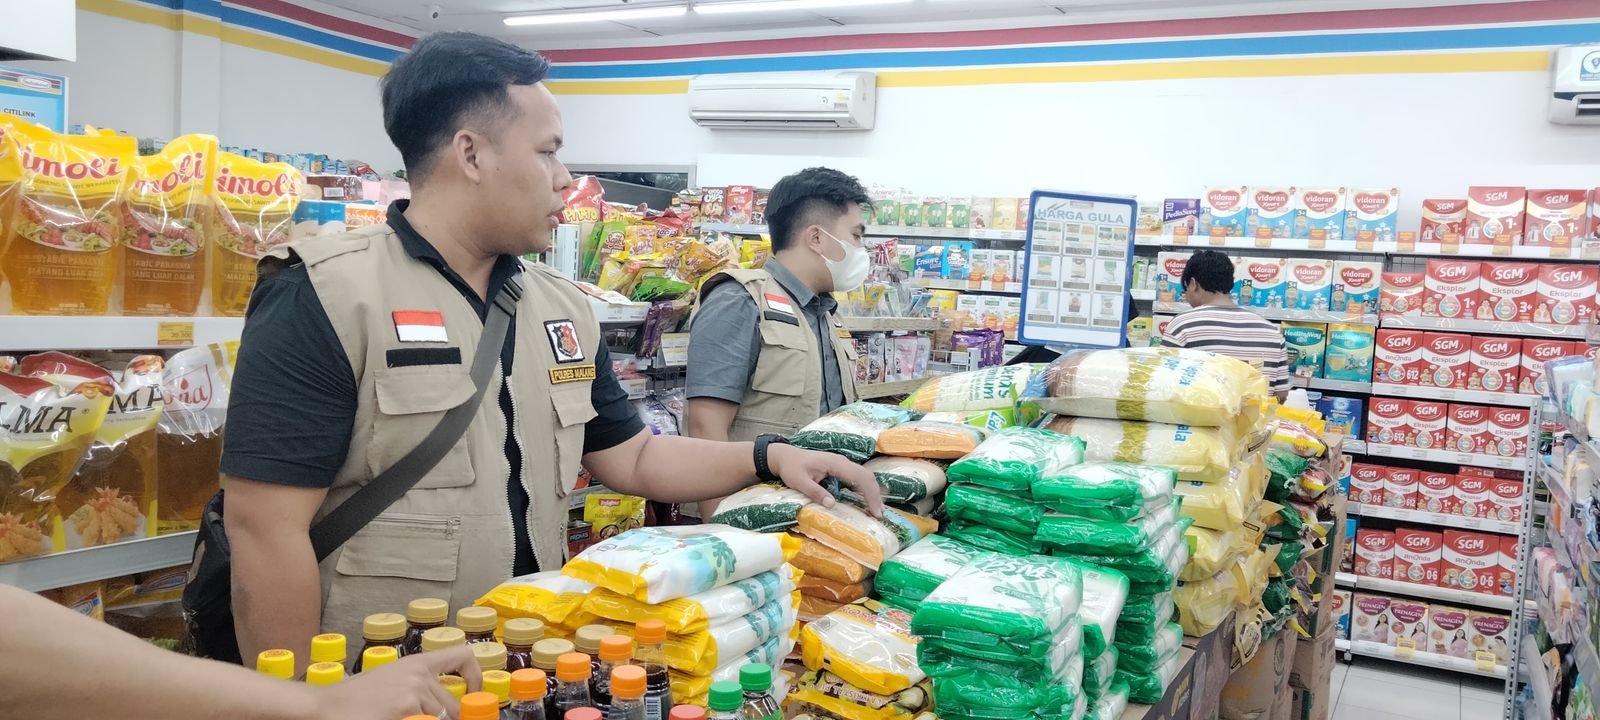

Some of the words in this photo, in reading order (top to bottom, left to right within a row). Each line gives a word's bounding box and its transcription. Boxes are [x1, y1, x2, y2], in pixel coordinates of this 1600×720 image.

[3, 108, 36, 118] CITILINK
[1485, 192, 1508, 201] SGM
[1546, 195, 1569, 205] SGM
[1436, 202, 1455, 210] SGM
[1037, 208, 1084, 221] HARGA
[1088, 212, 1124, 224] GULA
[1165, 209, 1197, 220] PediaSure
[916, 258, 940, 266] Ensure
[1295, 268, 1321, 276] vidoran
[1342, 271, 1370, 279] vidoran
[1439, 266, 1467, 277] SGM
[1495, 269, 1524, 280] SGM
[1553, 271, 1583, 282] SGM
[1394, 276, 1411, 284] SGM
[1436, 284, 1467, 292] Eksplor
[1492, 287, 1525, 295] Eksplor
[1549, 290, 1583, 298] Eksplor
[1387, 336, 1411, 347] SGM
[1435, 340, 1459, 350] SGM
[1483, 343, 1507, 353] SGM
[1535, 346, 1561, 357] SGM
[1360, 358, 1368, 367] 3
[1432, 356, 1459, 364] Eksplor
[554, 370, 574, 380] POLRES
[574, 367, 595, 379] MALANG
[1377, 403, 1399, 413] SGM
[1416, 406, 1438, 416] SGM
[1457, 409, 1479, 419] SGM
[1498, 413, 1520, 423] SGM
[1359, 470, 1377, 478] SGM
[1392, 473, 1411, 481] SGM
[1426, 477, 1447, 485] SGM
[1462, 481, 1482, 489] SGM
[1498, 485, 1518, 493] SGM
[1365, 537, 1386, 547] SGM
[1406, 537, 1430, 547] SGM
[1457, 539, 1484, 550] SGM
[1359, 602, 1386, 610] PRENAGEN
[1394, 608, 1423, 618] PRENAGEN
[1434, 616, 1463, 625] PRENAGEN
[1474, 621, 1504, 630] PRENAGEN
